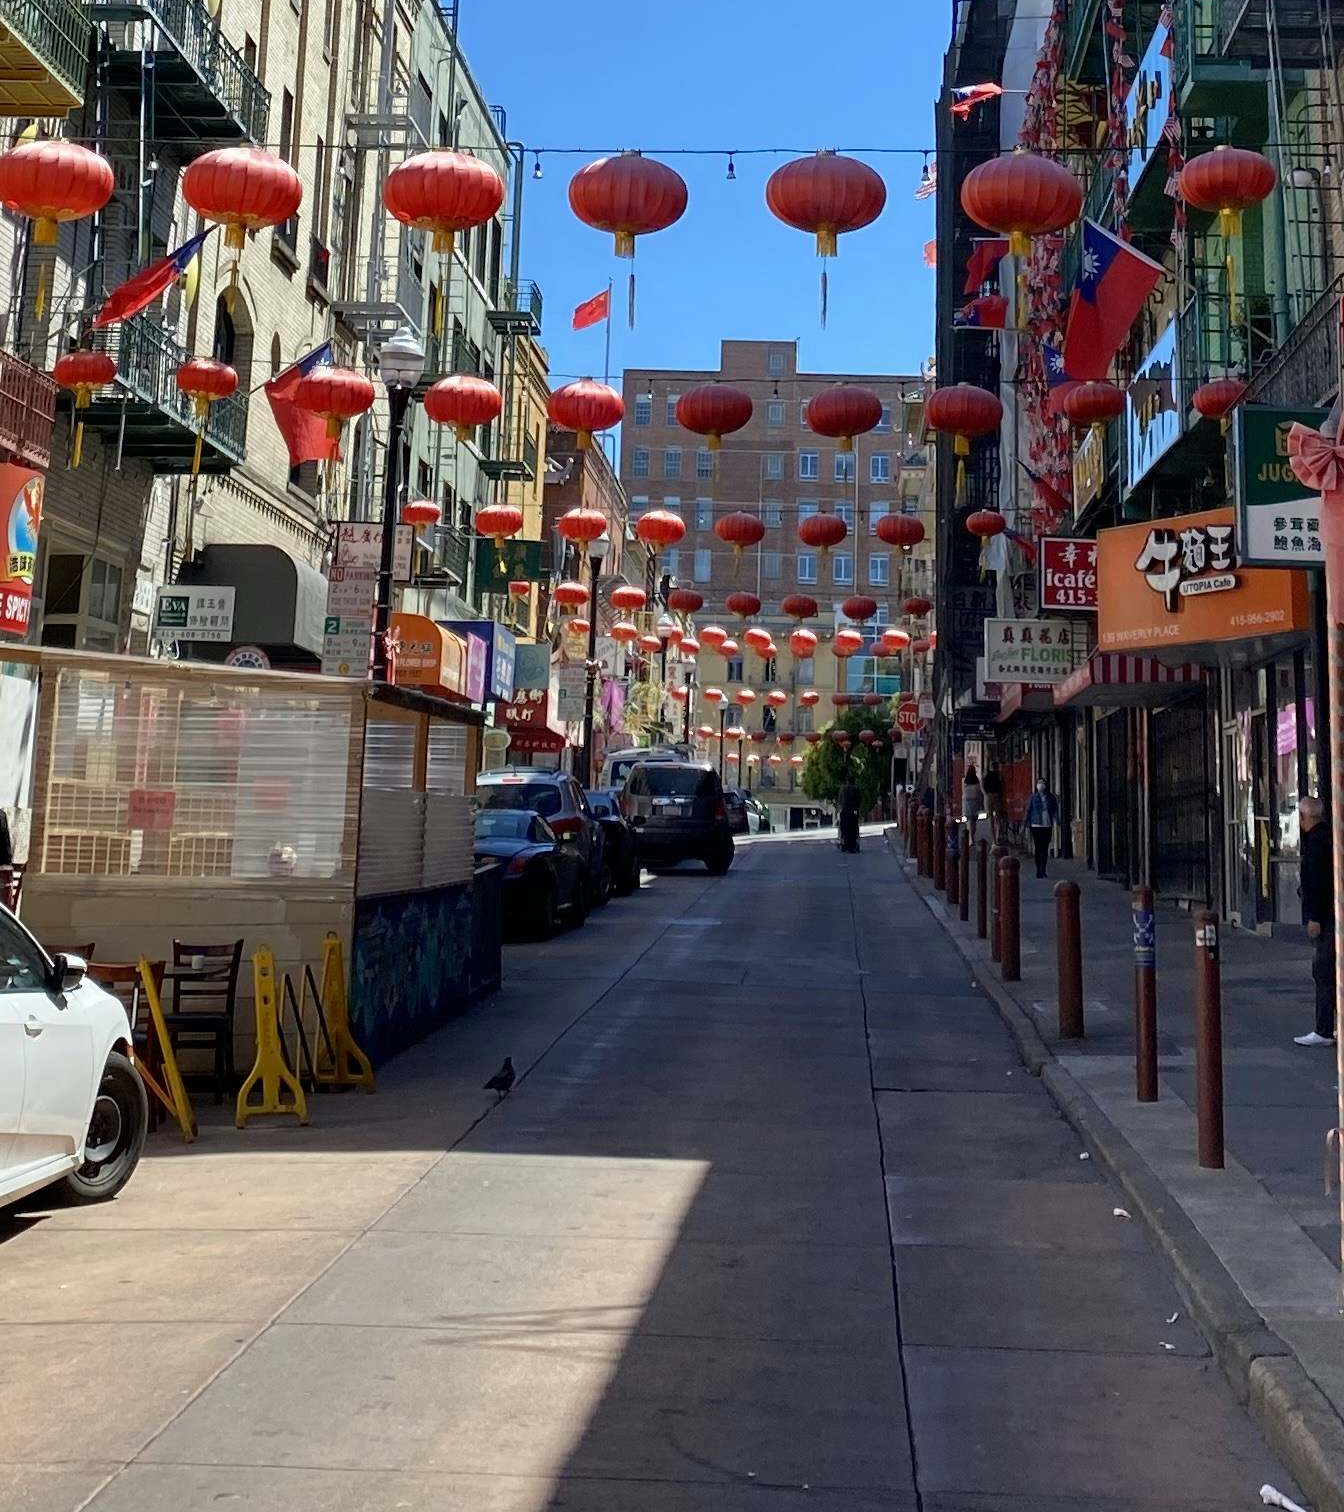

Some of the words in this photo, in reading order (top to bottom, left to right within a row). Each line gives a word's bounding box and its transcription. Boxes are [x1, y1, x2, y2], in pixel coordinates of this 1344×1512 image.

[330, 567, 344, 581] NO
[1183, 581, 1212, 594] UTOPIA
[1213, 577, 1232, 589] Cafe
[326, 619, 338, 634] 2
[1116, 627, 1153, 642] WAVERLY
[1154, 624, 1180, 638] PLACE
